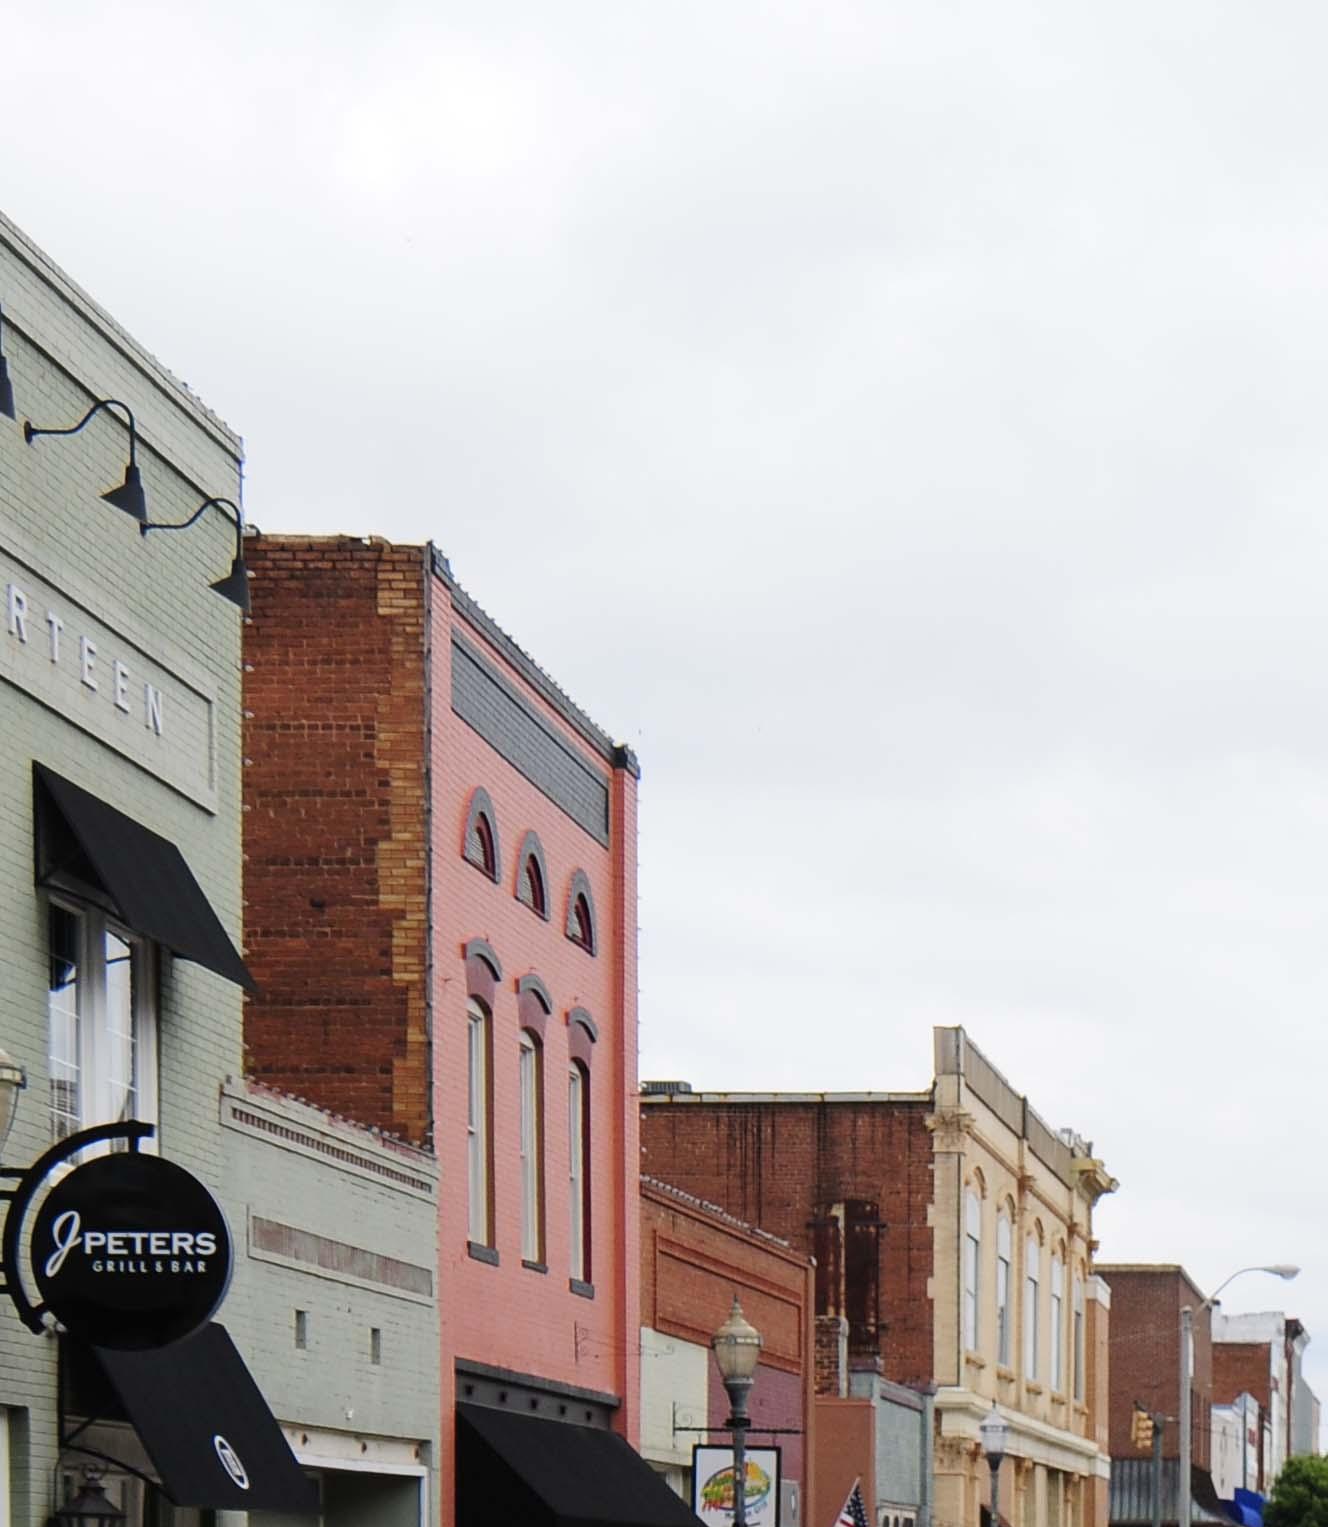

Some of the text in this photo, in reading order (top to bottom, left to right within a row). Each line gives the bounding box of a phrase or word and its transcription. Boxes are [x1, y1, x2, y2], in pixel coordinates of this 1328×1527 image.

[6, 583, 163, 736] RTEEN
[92, 1260, 148, 1273] GRILL
[170, 1260, 208, 1273] BAR
